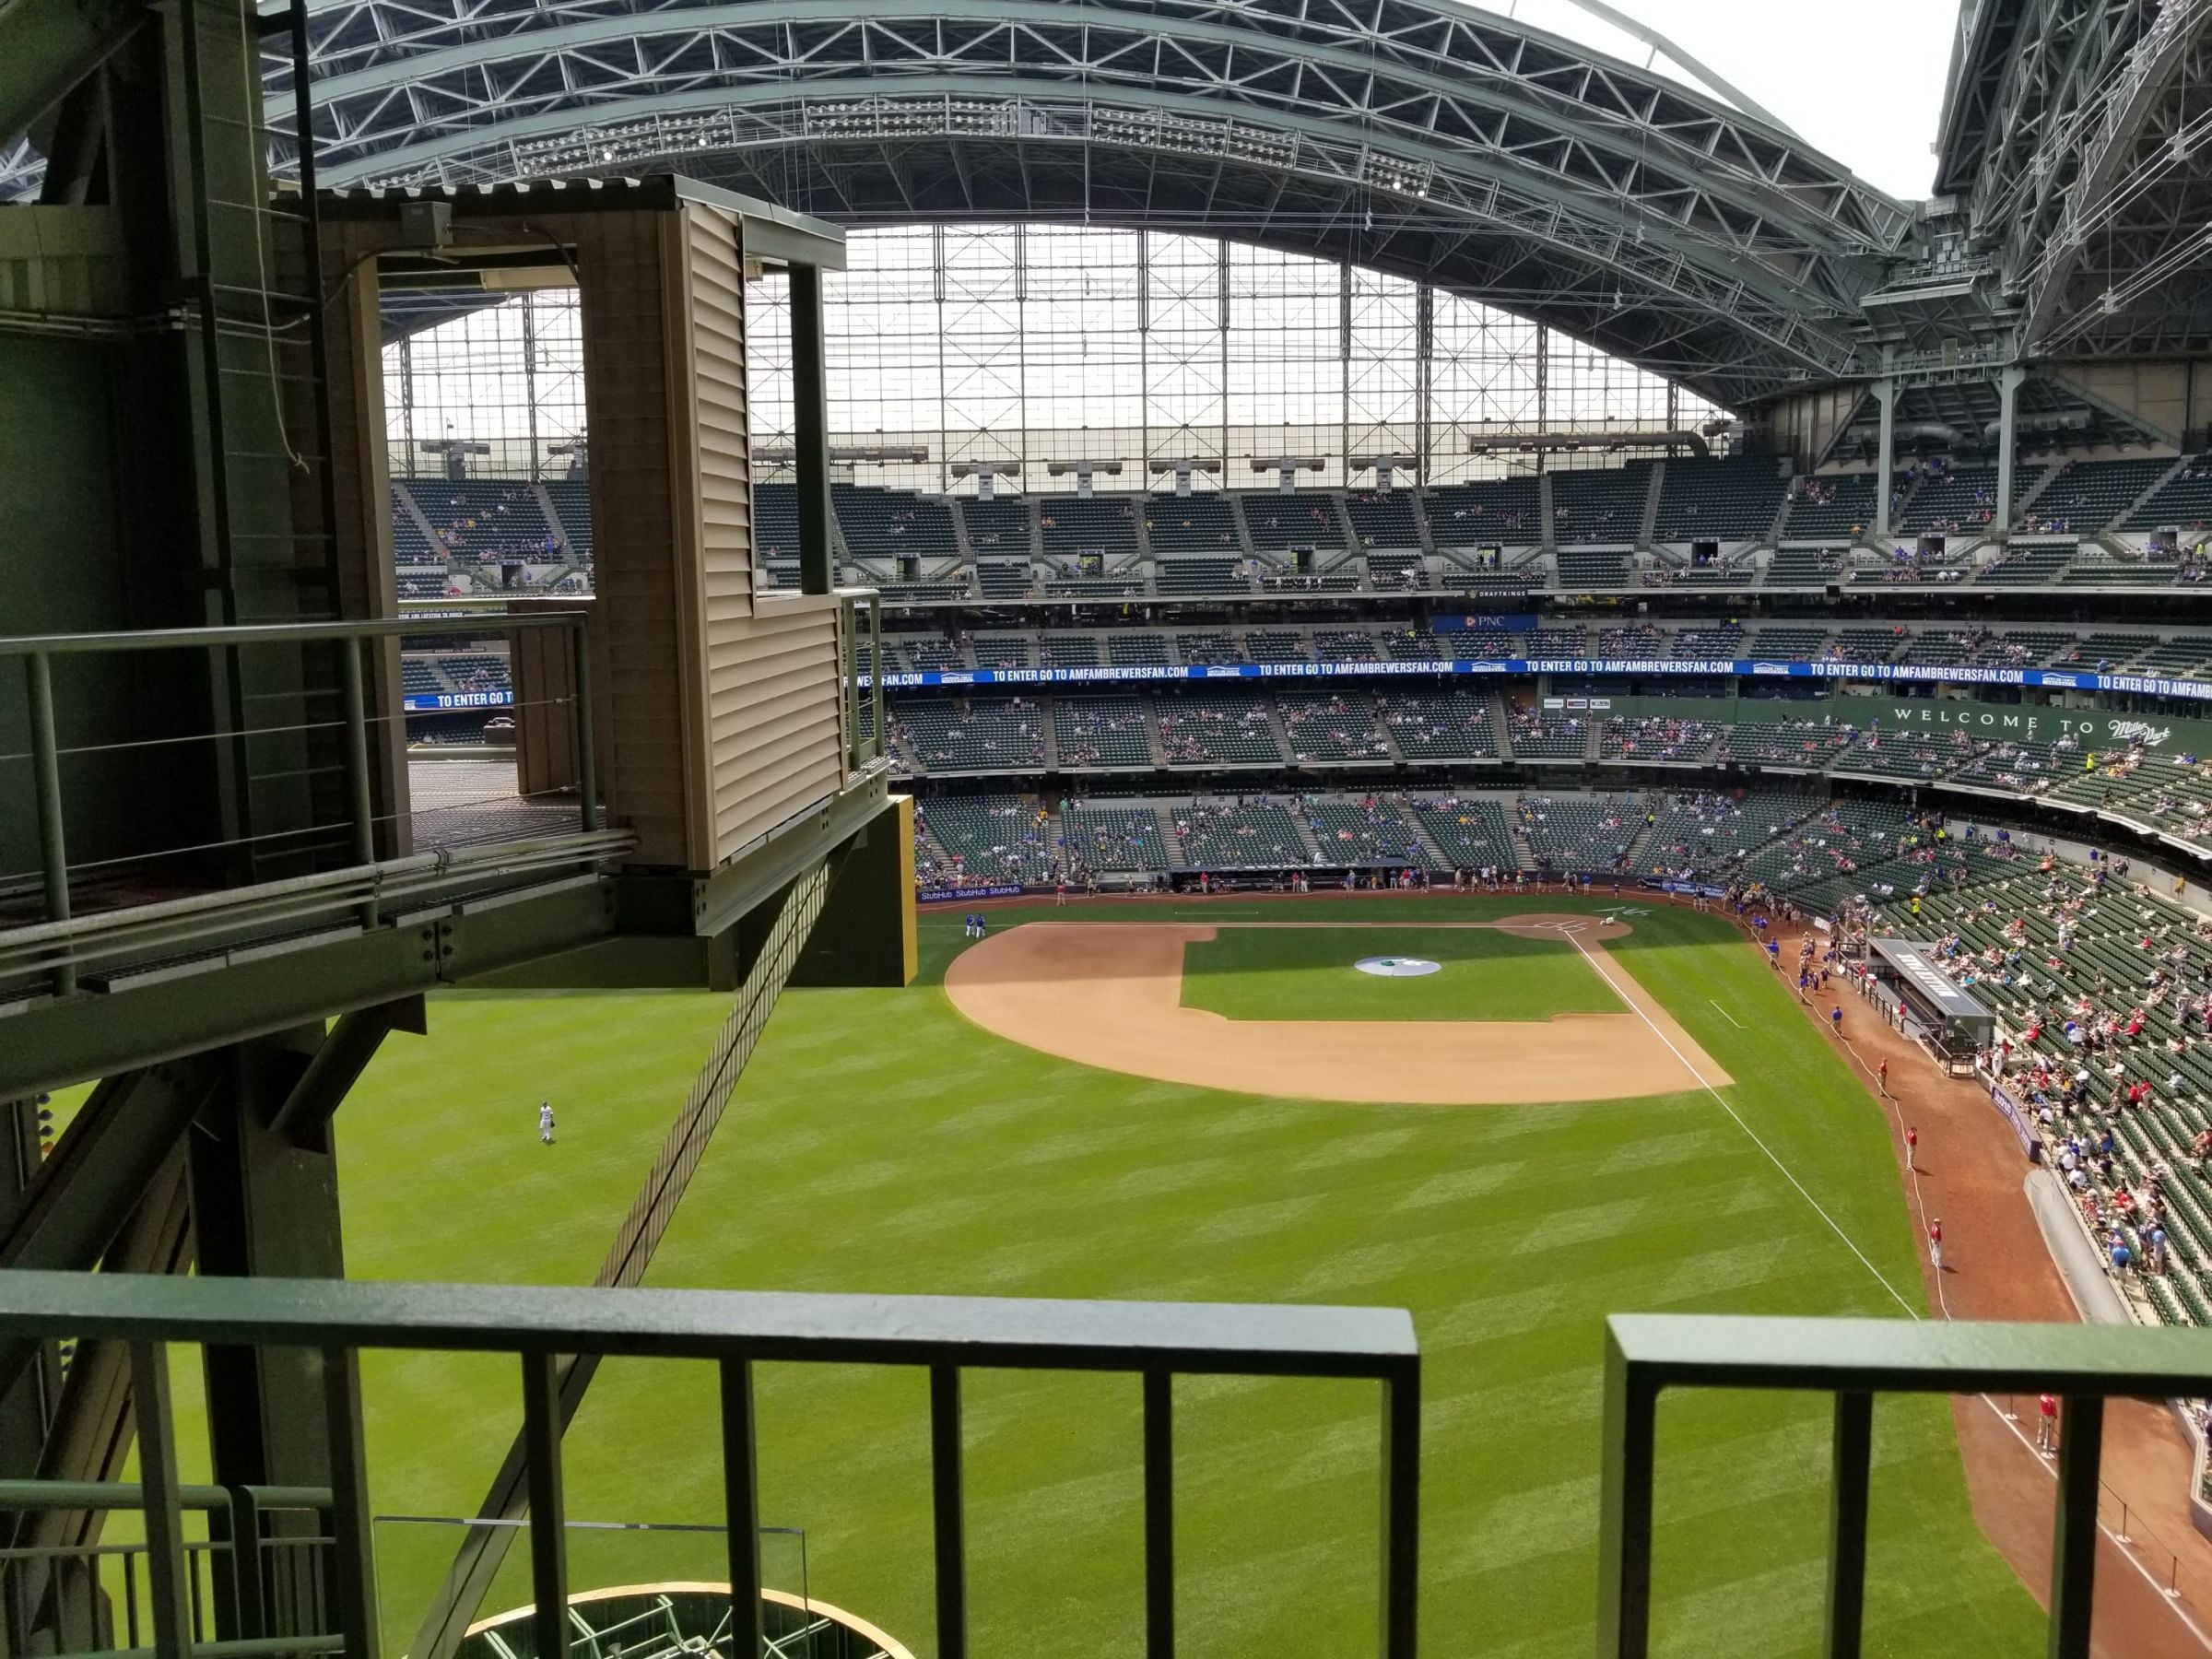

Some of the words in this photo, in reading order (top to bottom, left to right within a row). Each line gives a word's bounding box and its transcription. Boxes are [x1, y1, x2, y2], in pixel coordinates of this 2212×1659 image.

[1478, 616, 1505, 627] PNC
[994, 671, 1005, 680] TO
[1007, 670, 1037, 680] ENTER
[1040, 670, 1052, 679] GO
[1054, 669, 1066, 679] TO
[1069, 666, 1188, 680] AMFAMBREWERSFAN.COM
[1260, 665, 1271, 675] TO
[1274, 665, 1303, 675] ENTER
[1305, 664, 1318, 674] GO
[1321, 664, 1333, 674] TO
[1335, 663, 1453, 674] AMFAMBREWERSFAN.COM
[1526, 661, 1538, 671] TO
[1541, 661, 1571, 671] ENTER
[1574, 661, 1587, 671] GO
[1590, 661, 1602, 671] TO
[1605, 661, 1733, 673] AMFAMBREWERSFAN.COM
[1811, 664, 1823, 675] TO
[1827, 664, 1858, 676] ENTER
[1861, 665, 1875, 677] GO
[1877, 665, 1889, 677] TO
[1892, 666, 2023, 682] AMFAMBREWERSFAN.COM
[2098, 676, 2110, 688] TO
[2113, 677, 2141, 690] ENTER
[2144, 678, 2156, 692] GO
[2158, 680, 2170, 694] TO
[2171, 682, 2212, 700] AMFAMB
[438, 696, 452, 708] TO
[454, 693, 488, 707] ENTER
[489, 692, 503, 704] GO
[505, 691, 514, 703] T
[1895, 709, 2038, 729] WELCOME
[2061, 720, 2093, 734] TO
[922, 891, 953, 900] StubHub
[956, 888, 986, 898] StubHub
[989, 886, 1020, 895] StubHub
